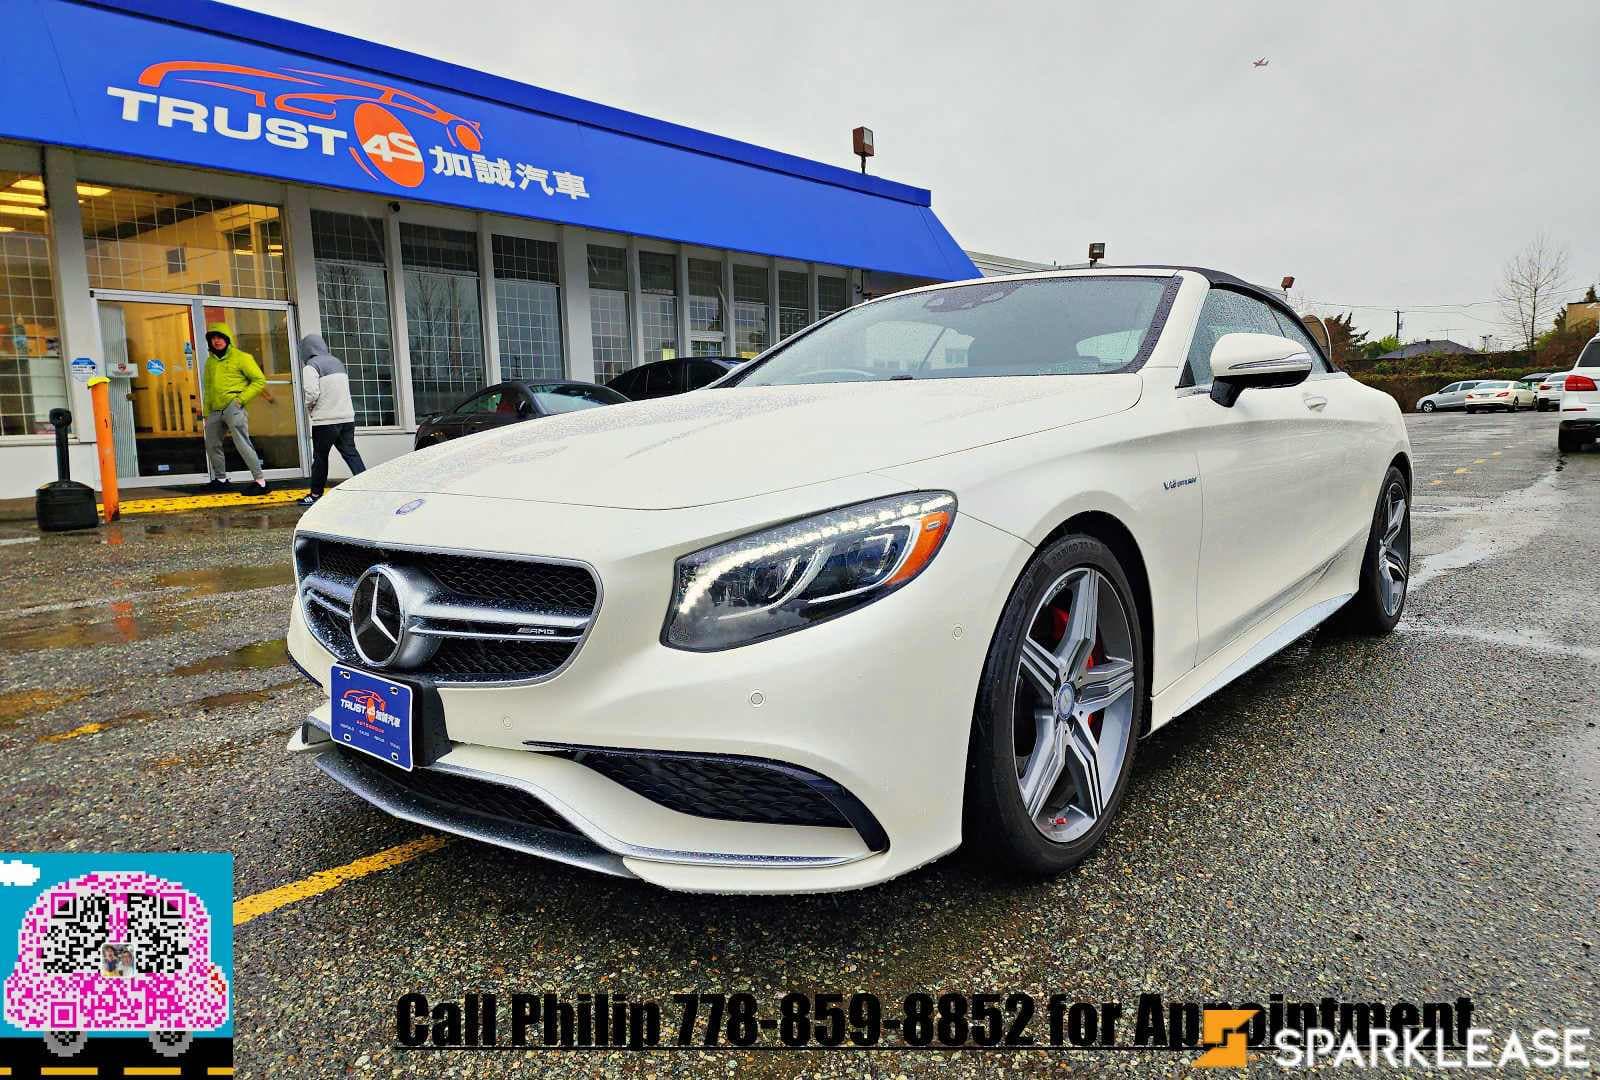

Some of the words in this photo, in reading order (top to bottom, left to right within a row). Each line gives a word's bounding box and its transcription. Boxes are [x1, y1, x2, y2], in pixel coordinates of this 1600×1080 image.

[107, 86, 347, 156] TRUST
[362, 132, 423, 162] 4S
[429, 145, 590, 200] 加誠汽車
[340, 698, 367, 714] TRUST
